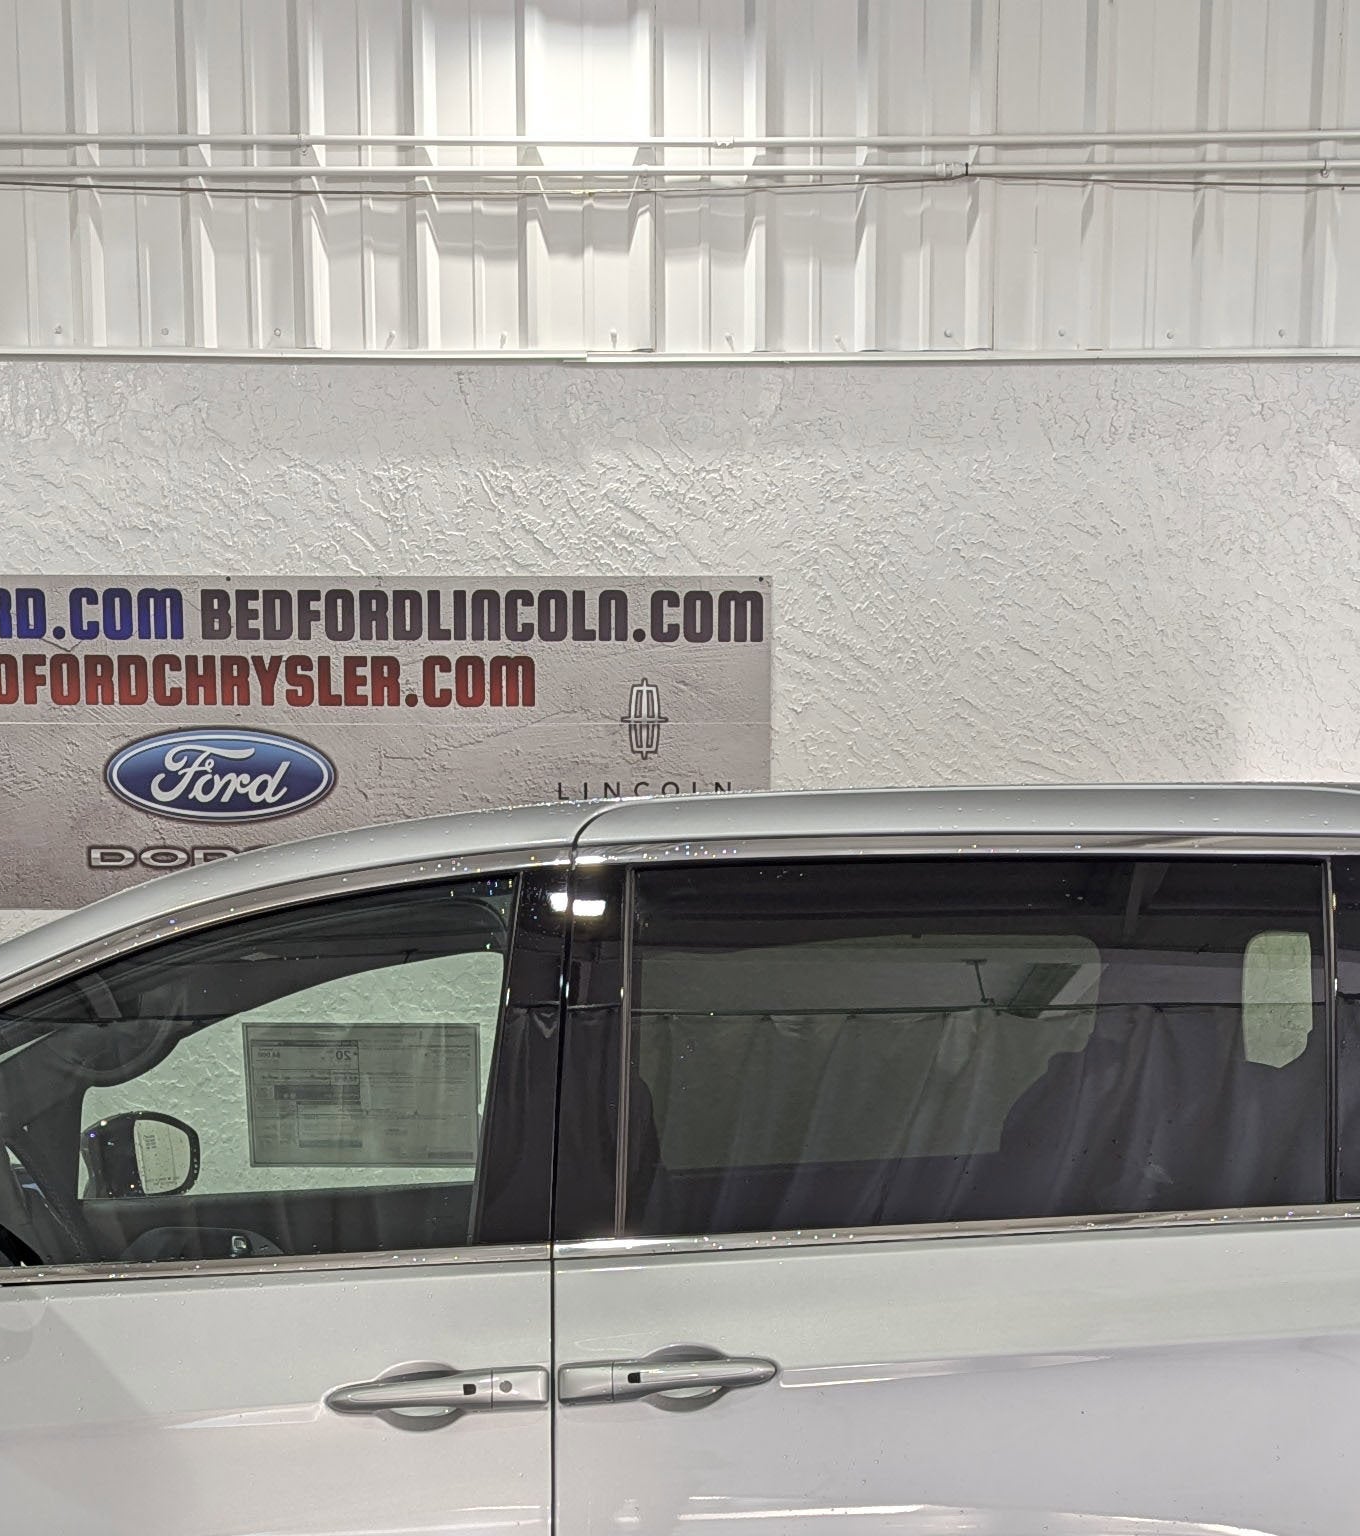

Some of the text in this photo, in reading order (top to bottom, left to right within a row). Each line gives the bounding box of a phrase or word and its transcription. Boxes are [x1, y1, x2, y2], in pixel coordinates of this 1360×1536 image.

[200, 588, 764, 642] BEDFORDLINCOLN.COM
[150, 744, 291, 803] Ford
[89, 846, 242, 868] DOD
